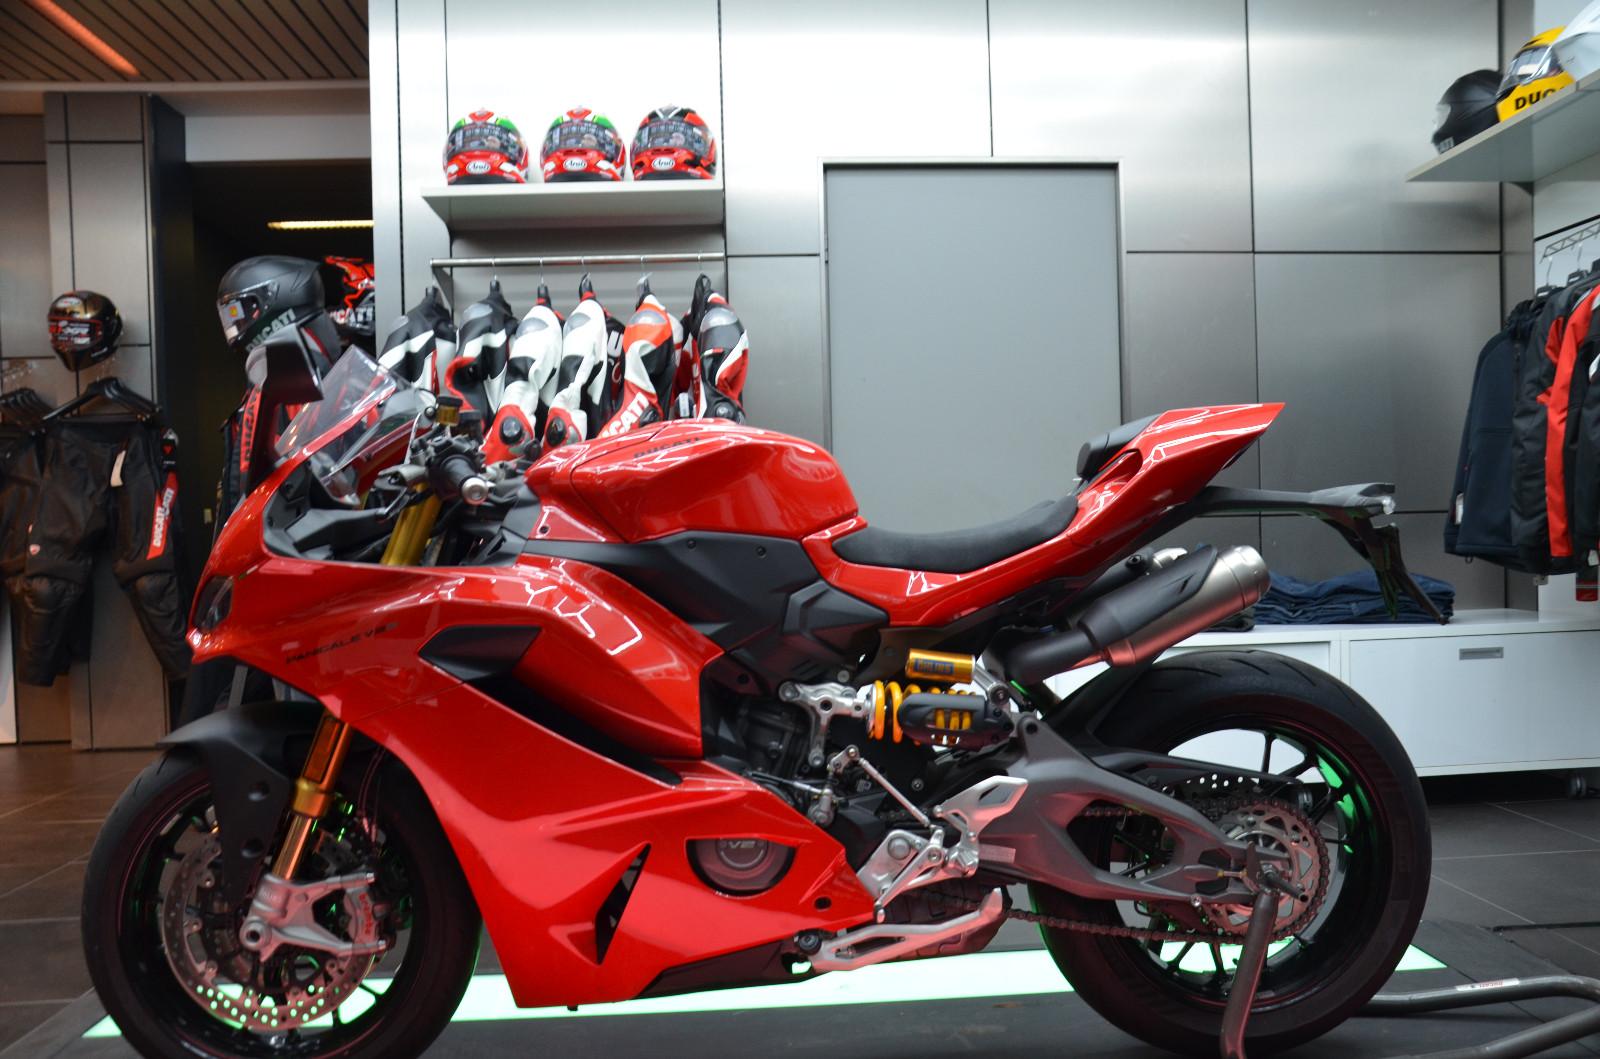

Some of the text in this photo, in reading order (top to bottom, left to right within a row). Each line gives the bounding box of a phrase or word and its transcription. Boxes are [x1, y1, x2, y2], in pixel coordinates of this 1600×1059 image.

[1514, 87, 1564, 110] DUC
[467, 162, 490, 171] Arai
[563, 159, 587, 169] Arai
[652, 158, 675, 168] Arai
